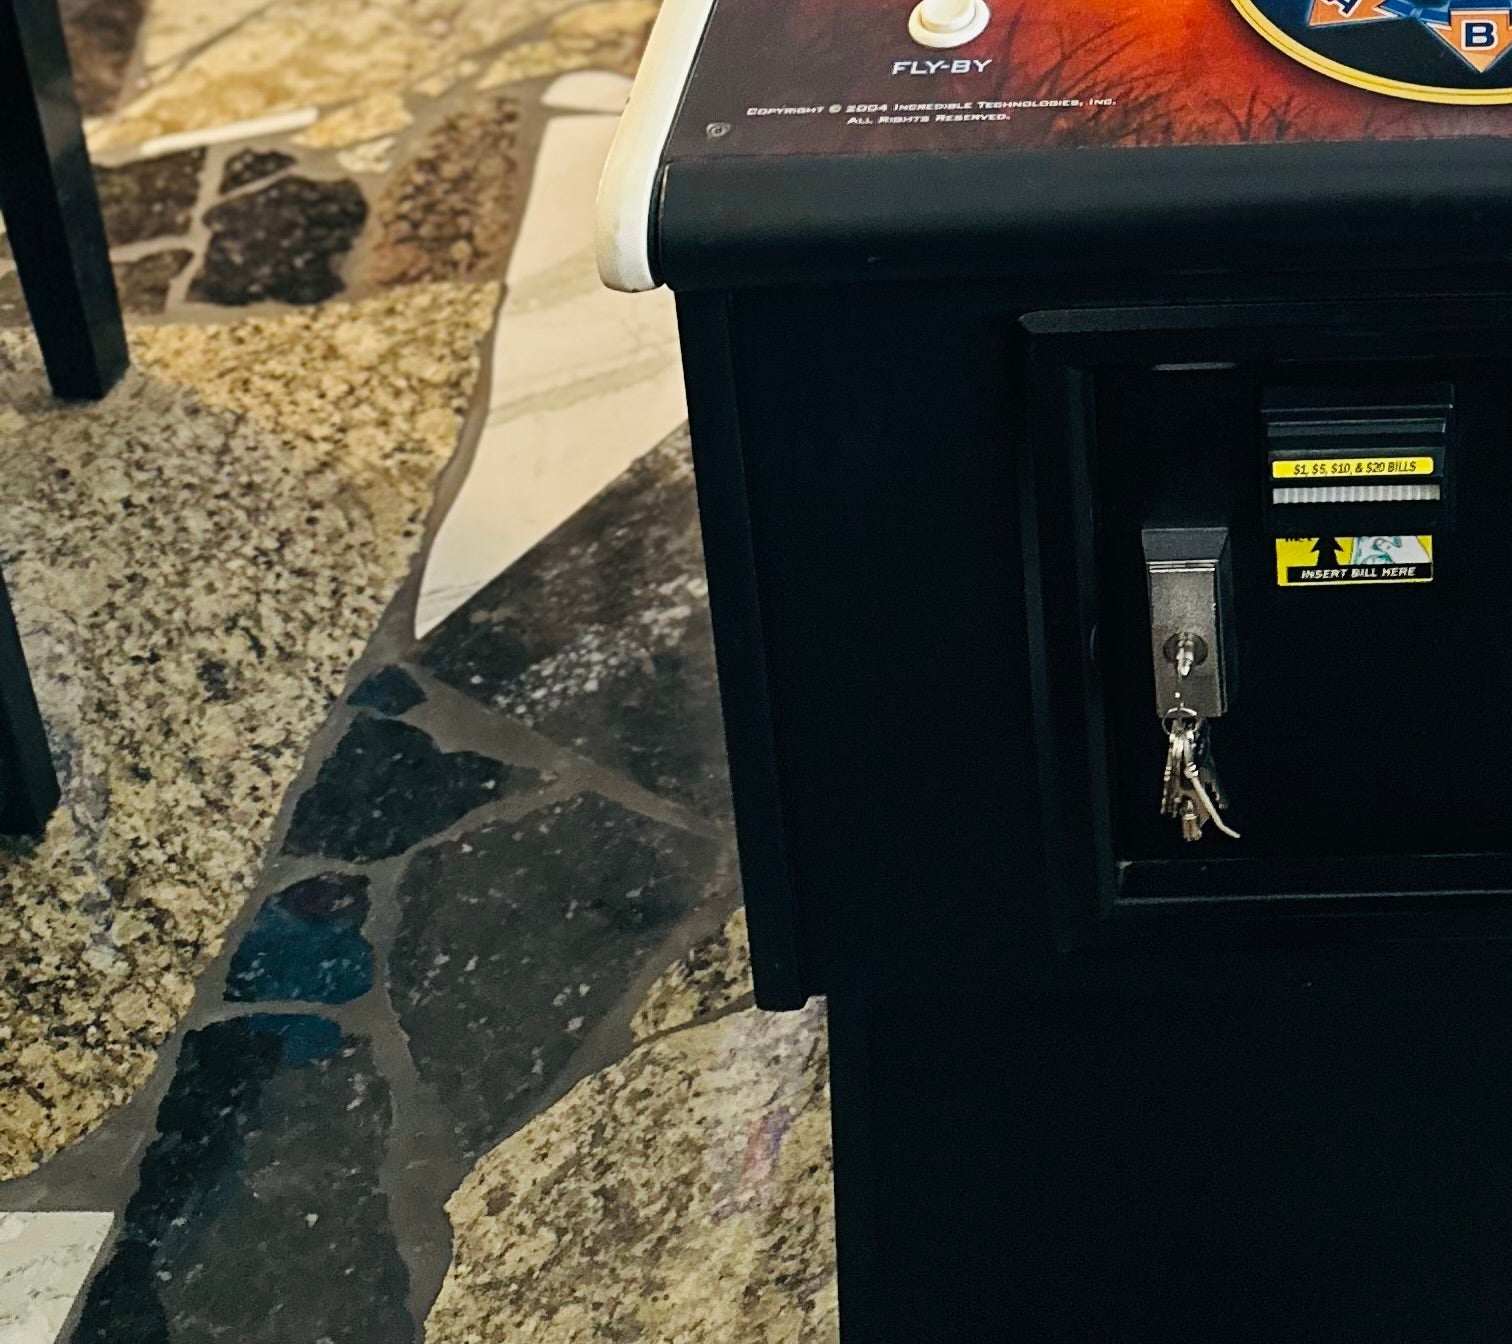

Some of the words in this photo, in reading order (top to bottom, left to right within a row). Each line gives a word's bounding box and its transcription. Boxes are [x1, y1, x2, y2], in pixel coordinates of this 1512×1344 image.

[1464, 22, 1496, 49] B
[891, 59, 993, 75] FLY-BY
[1365, 462, 1385, 473] $20
[1388, 461, 1417, 472] BILLS
[1301, 569, 1347, 579] INSERT
[1351, 568, 1377, 578] BILL
